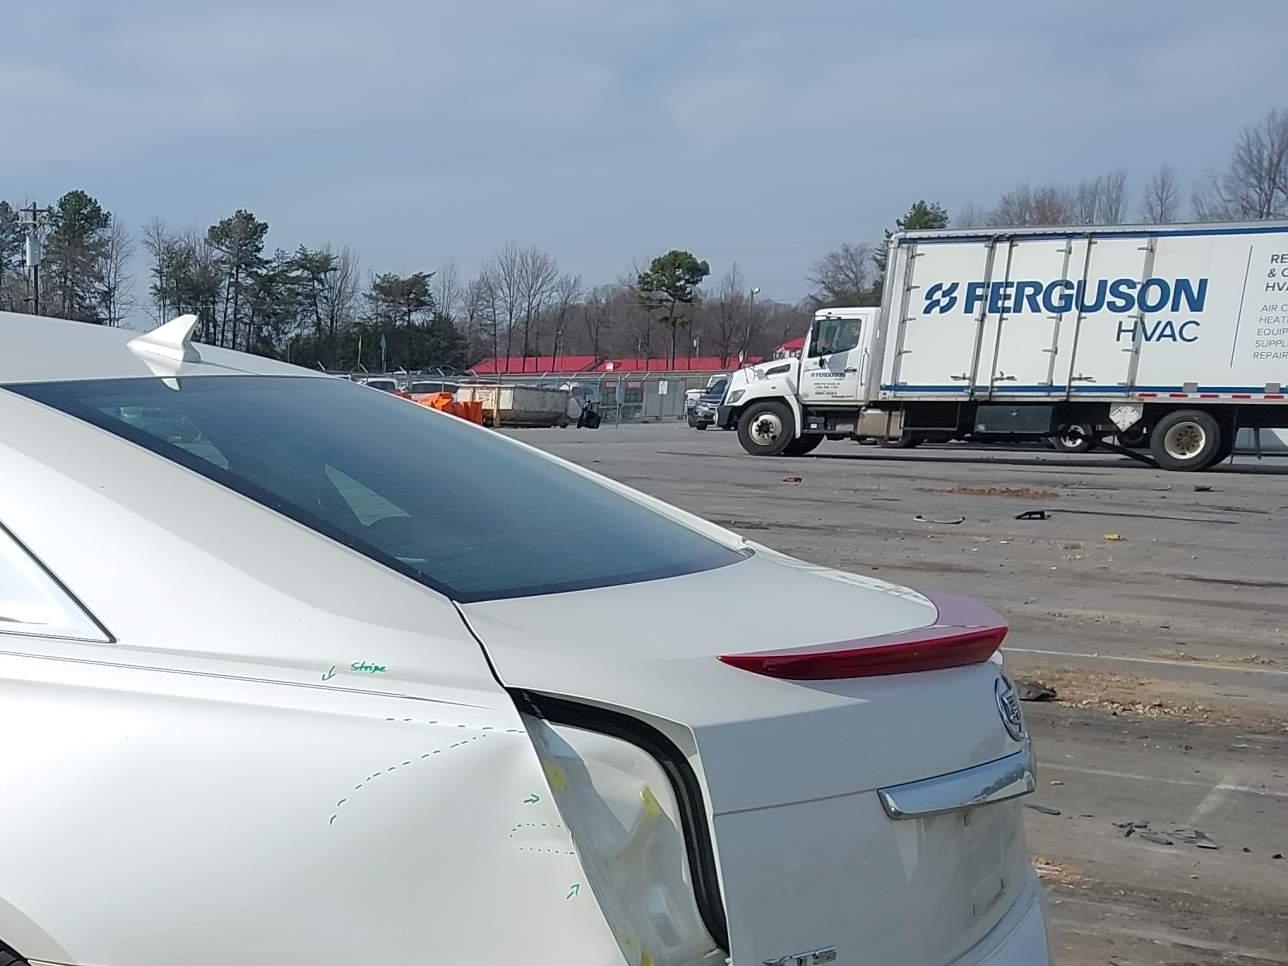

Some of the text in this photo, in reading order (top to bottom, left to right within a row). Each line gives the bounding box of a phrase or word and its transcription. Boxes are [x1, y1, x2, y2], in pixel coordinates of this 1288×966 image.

[1267, 268, 1276, 278] &
[1265, 282, 1288, 292] HV
[963, 278, 1209, 314] FERGUSON
[1261, 304, 1278, 312] AIR
[1116, 320, 1201, 342] HVAC
[1255, 339, 1288, 348] SUPPL
